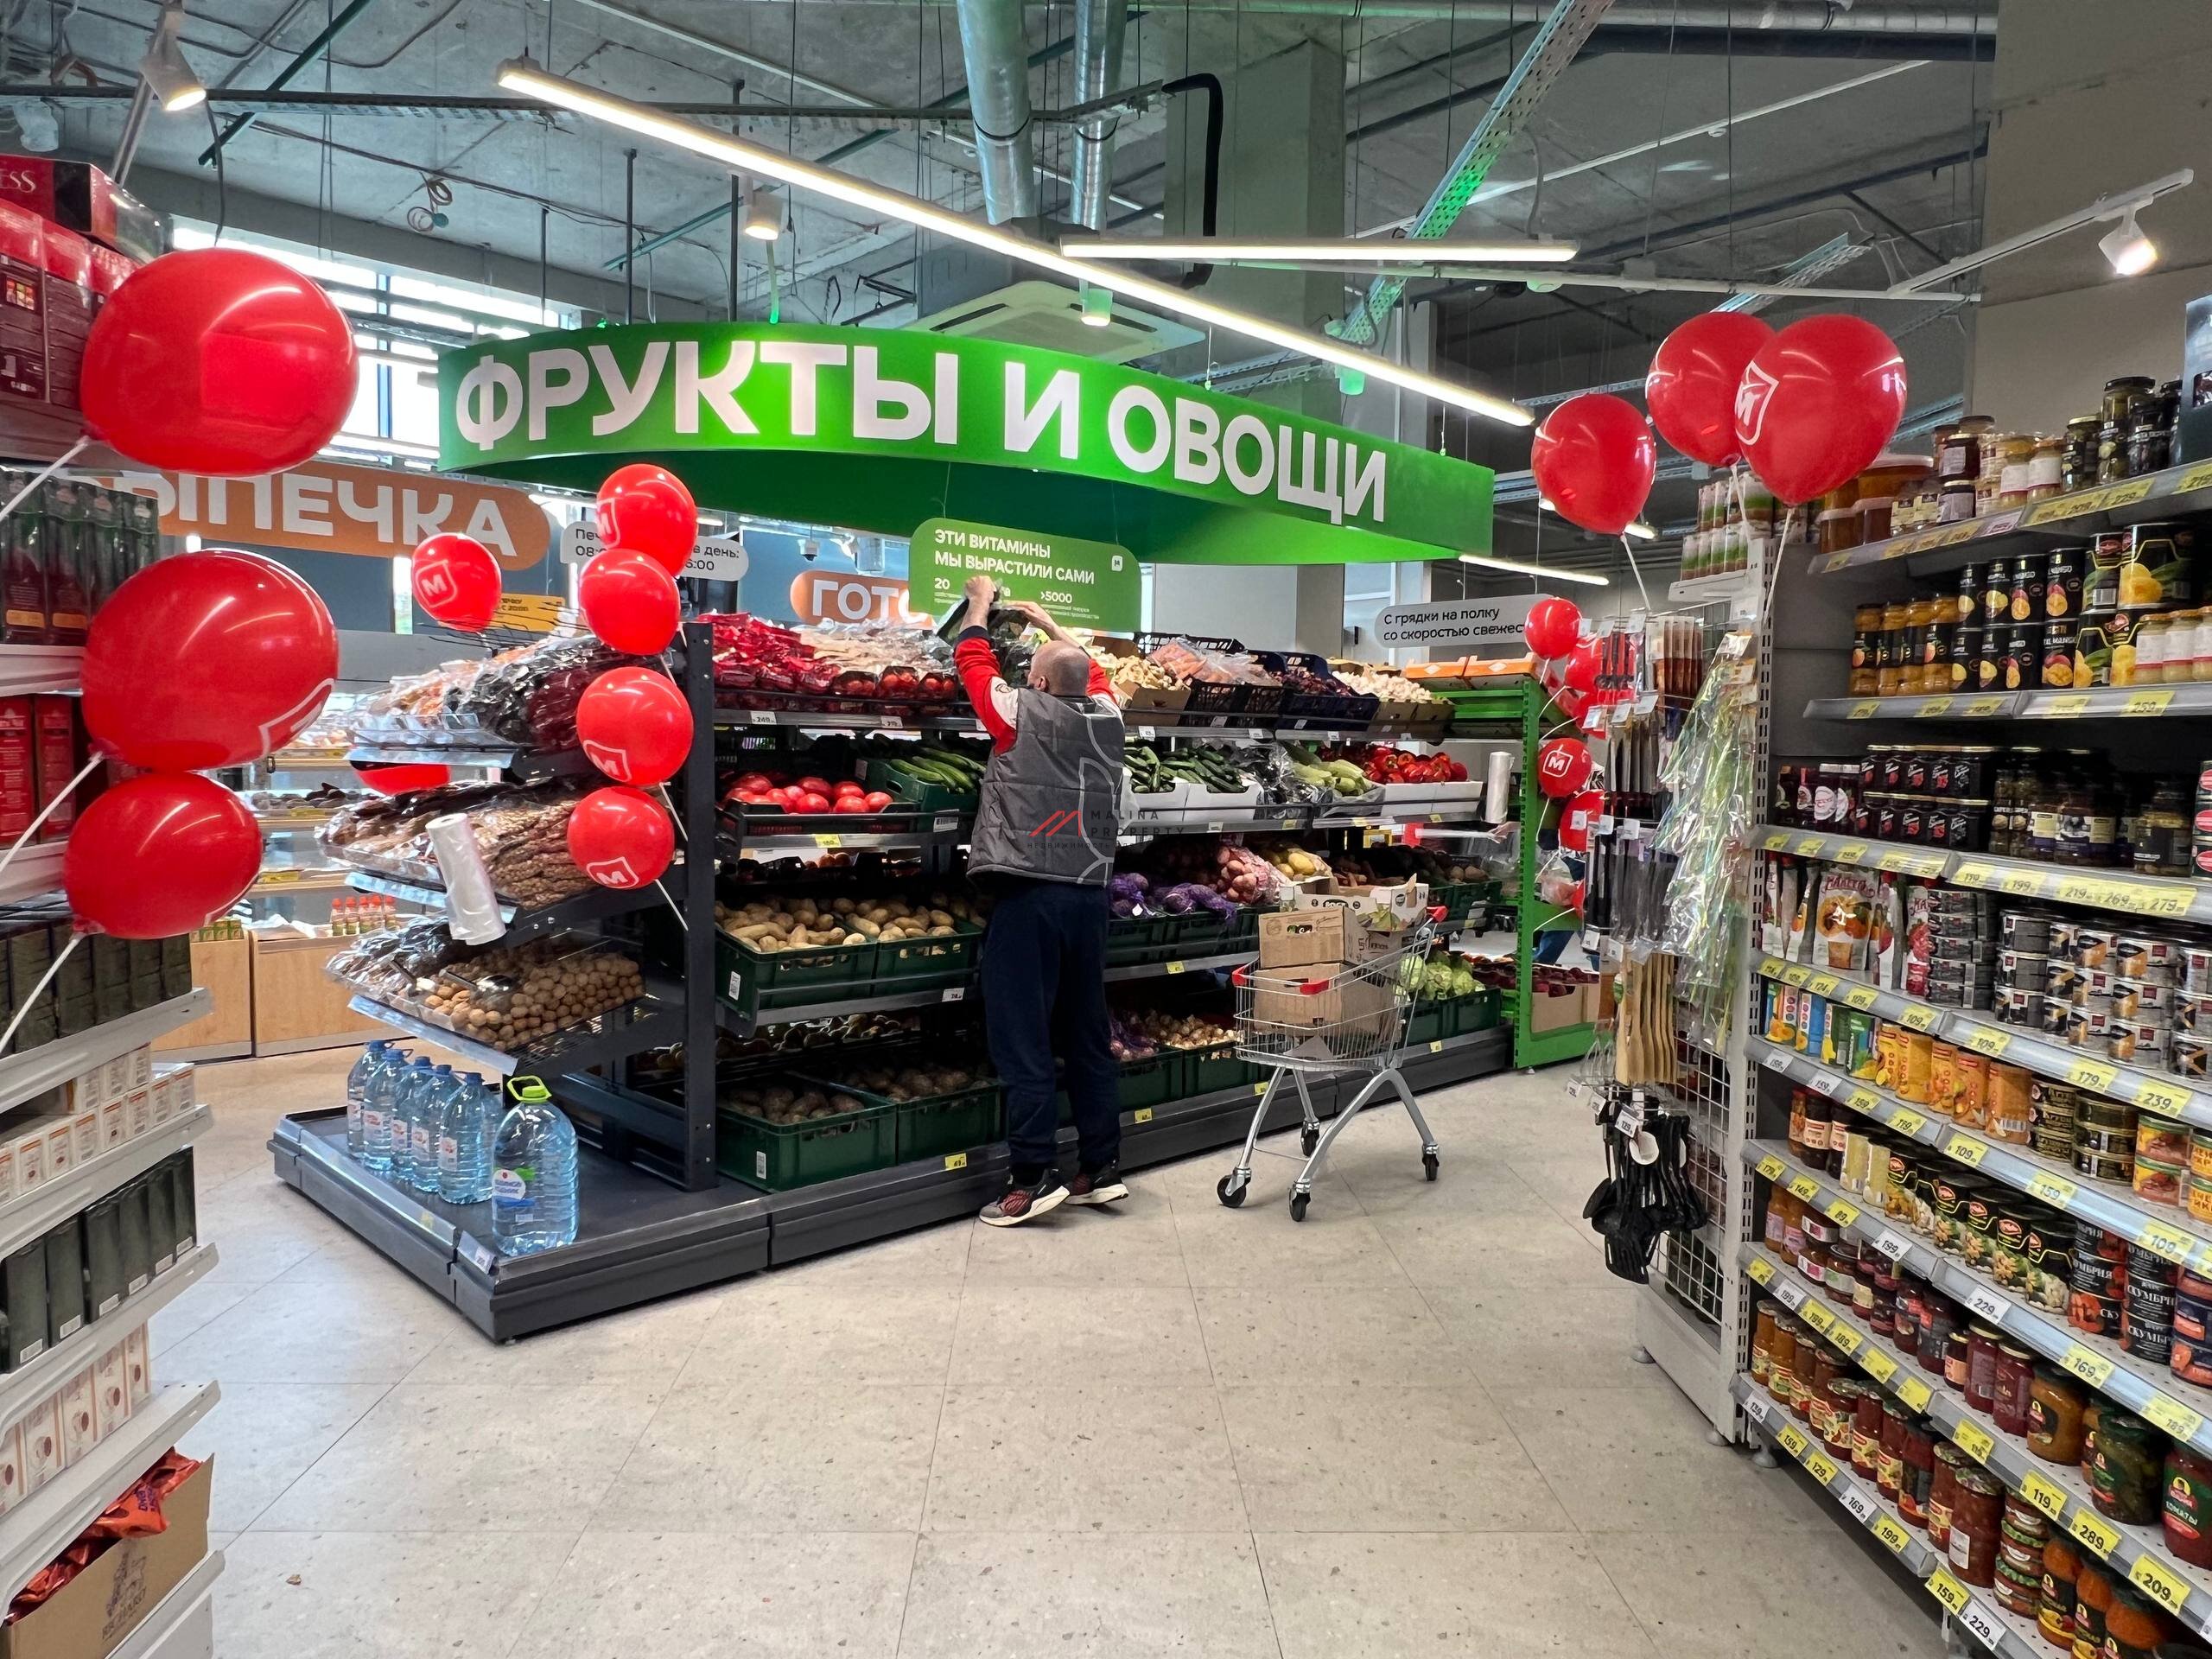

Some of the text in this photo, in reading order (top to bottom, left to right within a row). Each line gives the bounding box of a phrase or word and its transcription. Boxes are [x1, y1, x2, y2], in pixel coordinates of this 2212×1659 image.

[455, 340, 1387, 524] ФРУКТЫ И ОВОЩИ
[91, 471, 518, 557] ЫПЕЧКА
[703, 545, 740, 559] день:
[934, 529, 1052, 559] ЭТИ ВИТАМИНЫ
[934, 550, 1095, 585] МЫ ВЫРАСТИЛИ САМИ
[934, 577, 950, 590] 20
[1384, 607, 1500, 626] С грядки на полку
[1383, 623, 1525, 641] со скоростью свежес
[2142, 1093, 2172, 1110] 239
[2151, 1235, 2177, 1254] 109
[1974, 1299, 1995, 1315] 229
[2074, 1357, 2096, 1379] 169
[2032, 1489, 2052, 1509] 119
[2079, 1525, 2105, 1550] 289
[1936, 1582, 1955, 1604] 159
[2142, 1573, 2172, 1603] 209
[1968, 1615, 1991, 1639] 229
